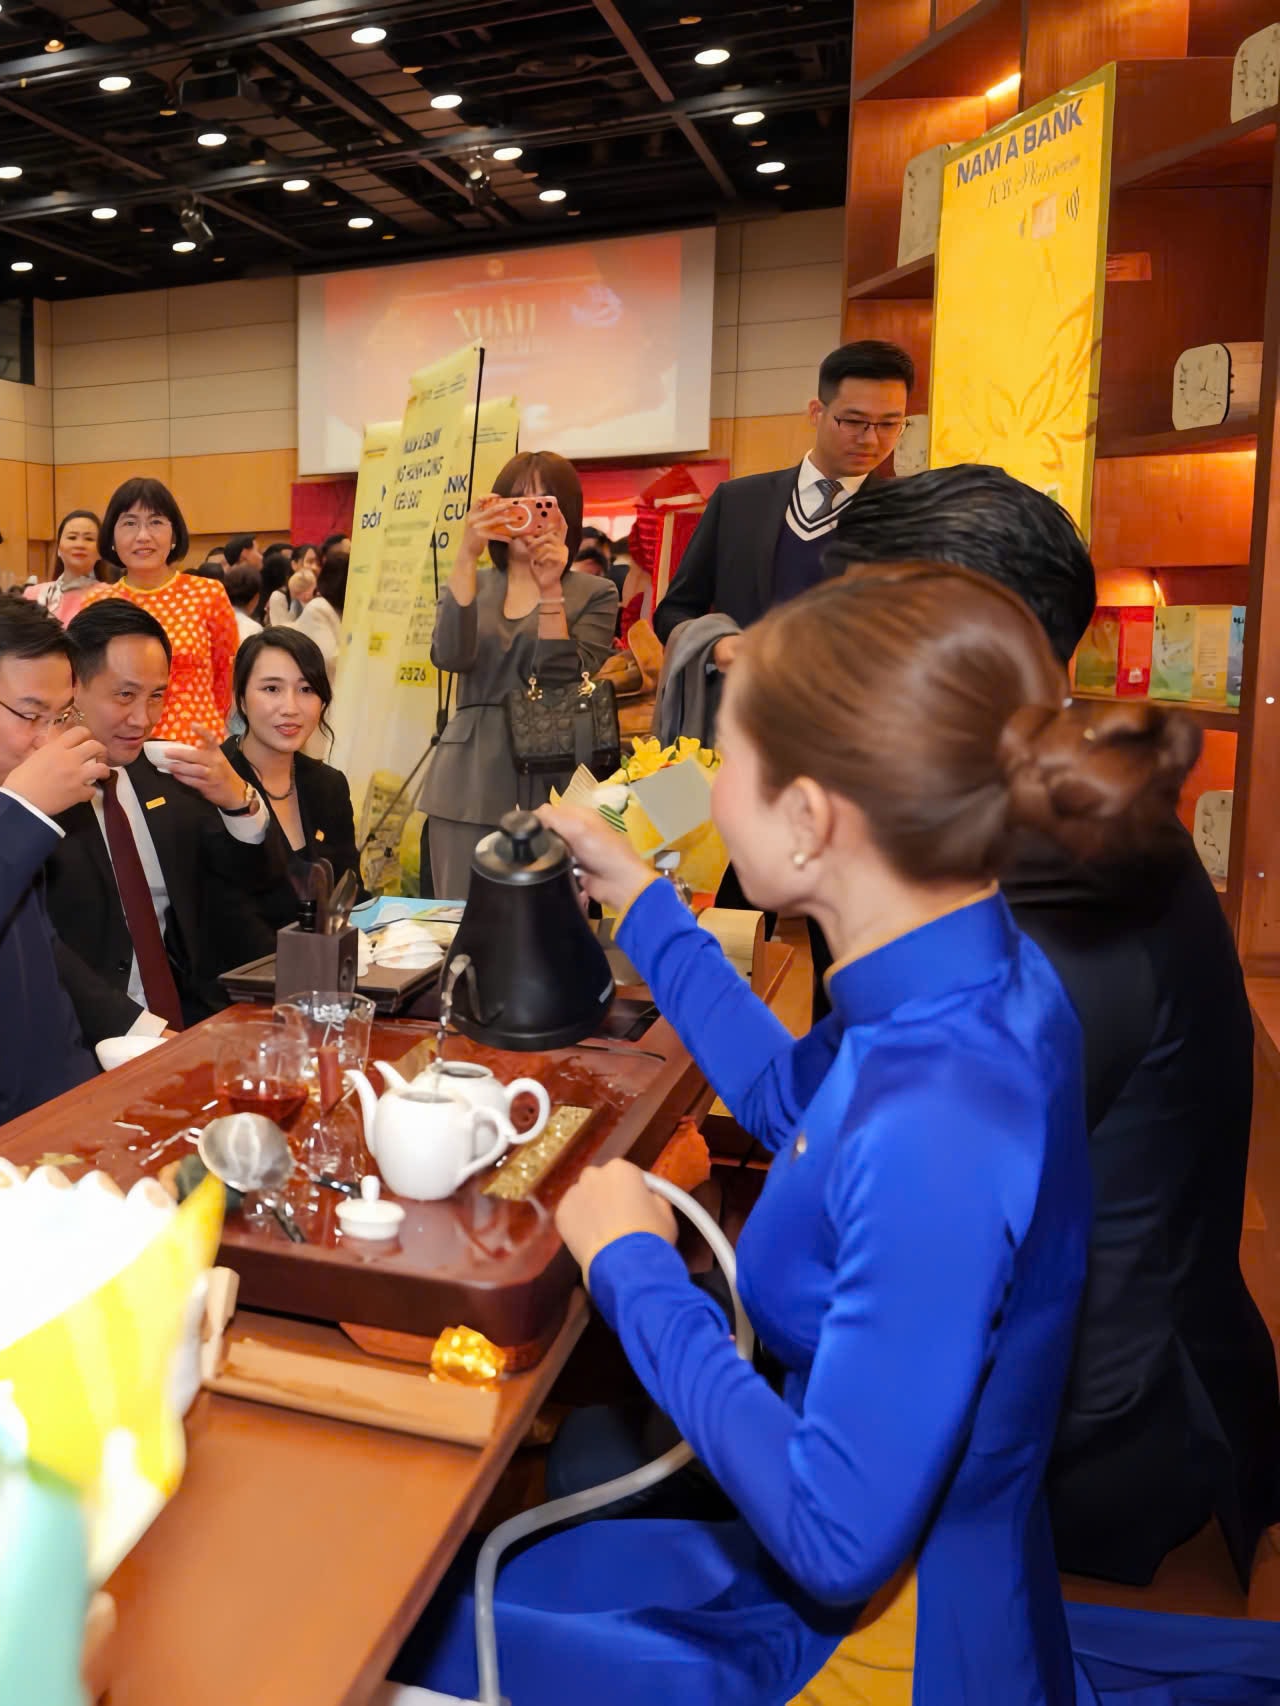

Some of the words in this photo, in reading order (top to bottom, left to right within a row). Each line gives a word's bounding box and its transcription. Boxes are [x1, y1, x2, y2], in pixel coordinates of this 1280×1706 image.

[956, 142, 1002, 188] NAM
[1005, 134, 1019, 164] A
[1023, 98, 1083, 154] BANK
